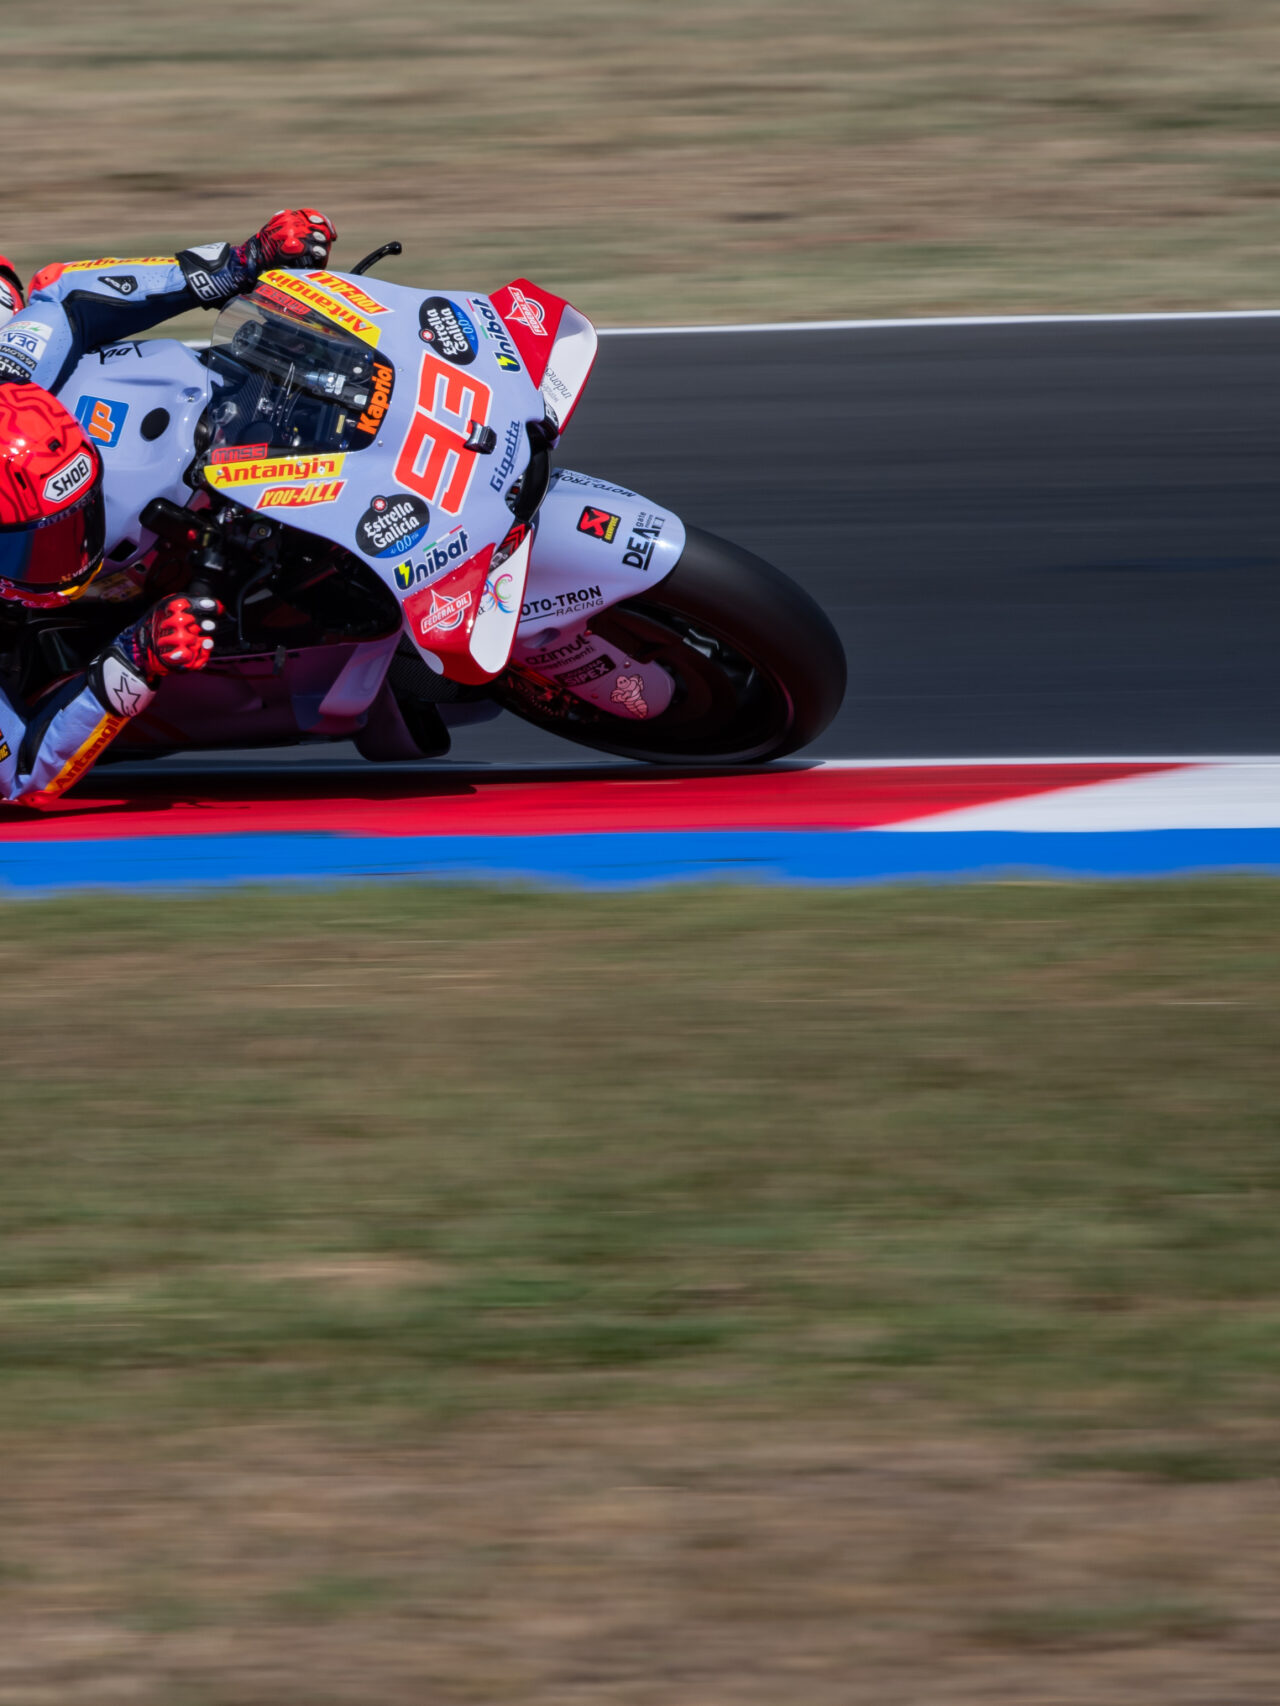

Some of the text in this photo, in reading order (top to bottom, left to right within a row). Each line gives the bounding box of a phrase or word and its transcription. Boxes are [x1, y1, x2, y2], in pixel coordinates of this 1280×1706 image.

[266, 271, 373, 333] Antangin
[310, 271, 380, 313] YOU-ALL
[427, 308, 458, 355] Estrella
[441, 307, 469, 352] Galicia
[472, 298, 521, 372] Unibat
[521, 303, 542, 333] FEDERAL
[356, 362, 393, 435] Kapriol
[394, 352, 492, 516] 93
[215, 458, 335, 484] Antangin
[490, 420, 520, 492] Gigetta
[52, 459, 90, 496] SHOEI
[262, 481, 338, 506] YOU-ALL
[364, 502, 414, 538] Estrella
[373, 516, 419, 548] Galicia
[393, 530, 468, 590] Unibat
[423, 605, 455, 629] FEDERAL
[456, 597, 468, 609] OIL
[521, 585, 602, 616] OTO-TRON
[556, 597, 604, 616] RACING
[525, 634, 591, 665] azimut
[55, 717, 123, 788] Antangi
